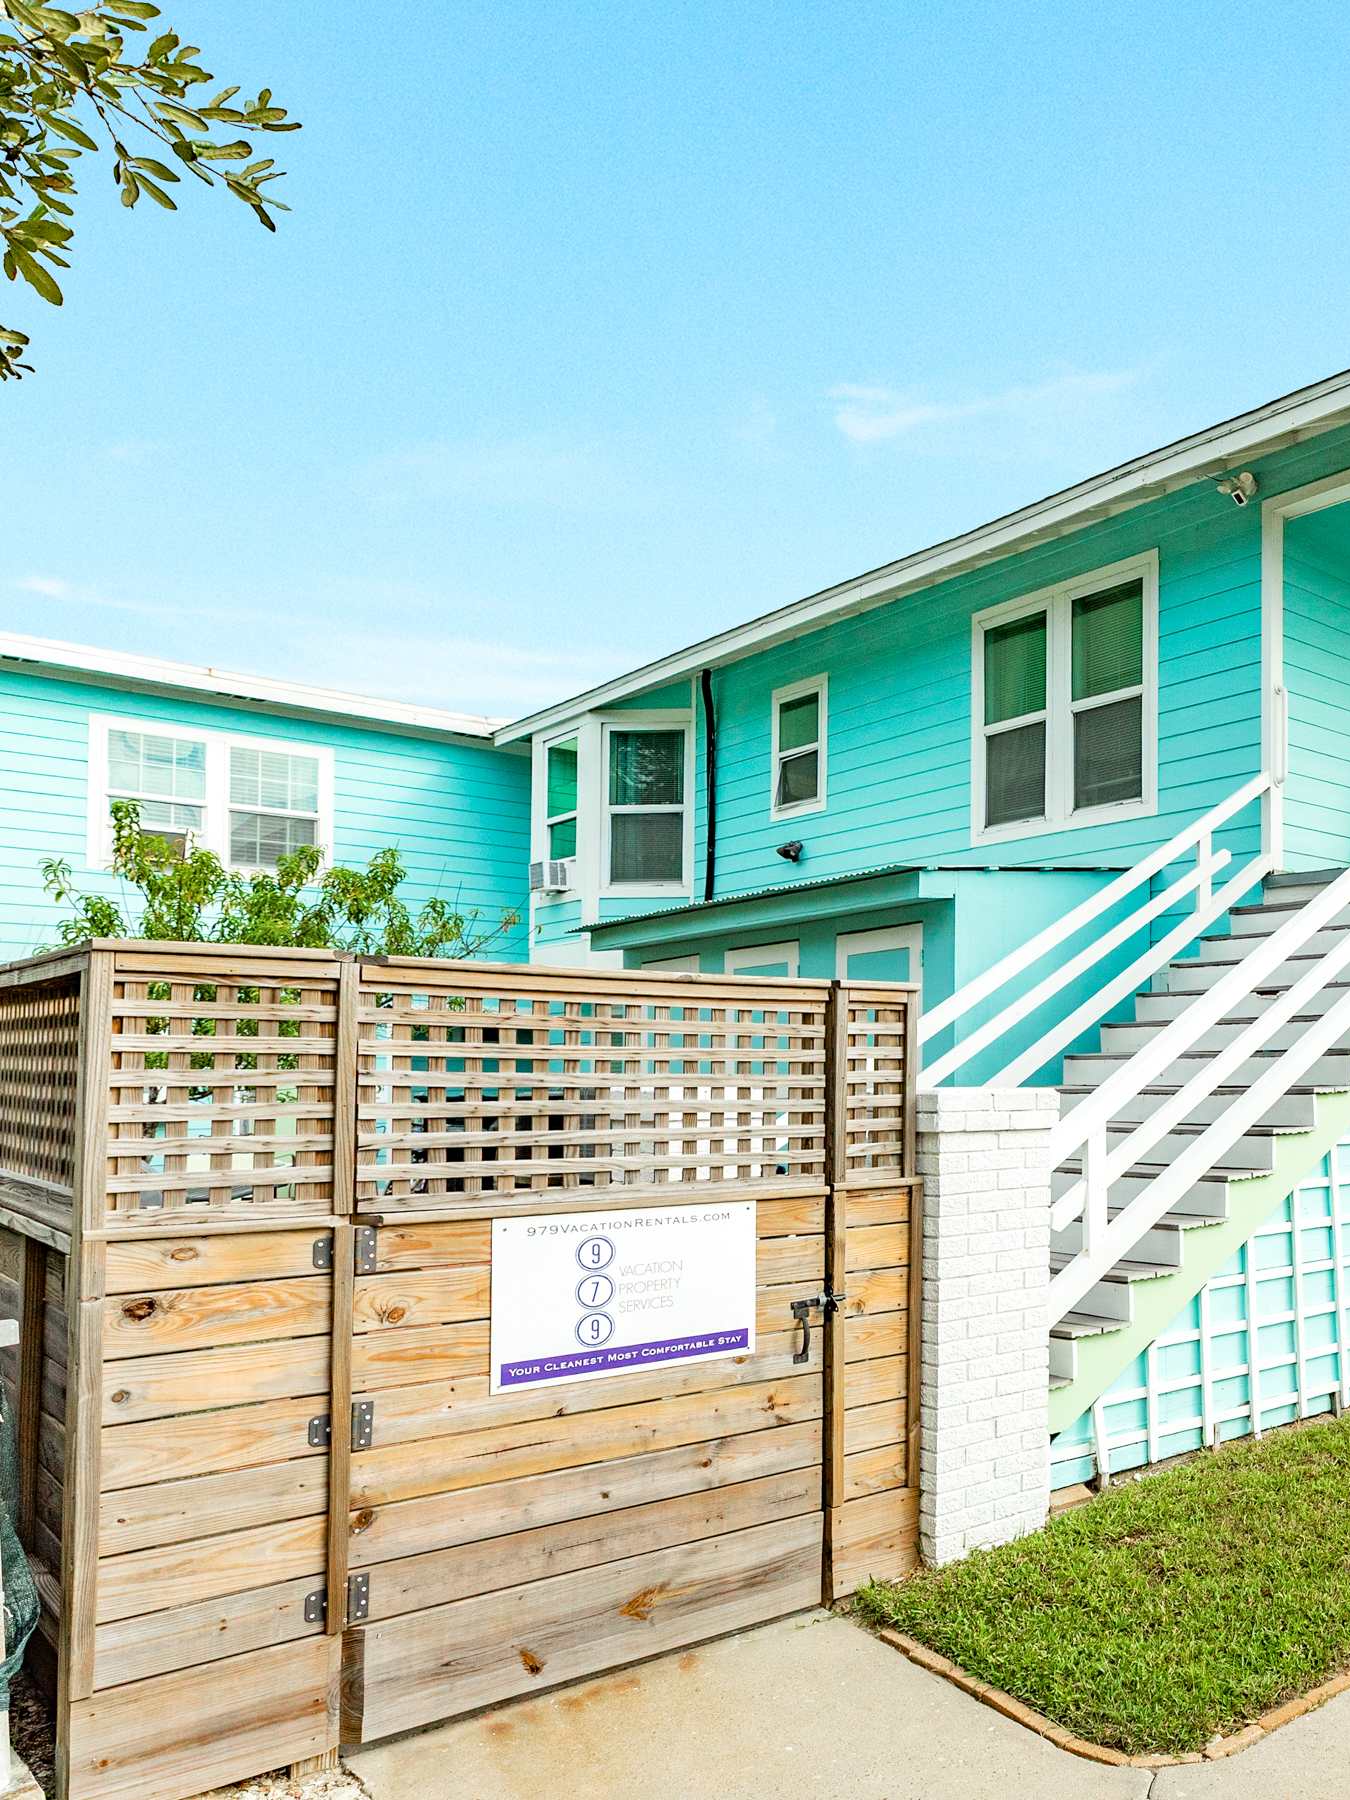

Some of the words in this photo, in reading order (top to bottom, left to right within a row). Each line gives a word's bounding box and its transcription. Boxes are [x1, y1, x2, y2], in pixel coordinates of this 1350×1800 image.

[591, 1243, 601, 1264] 9
[618, 1259, 683, 1277] VACATION
[591, 1281, 600, 1303] 7
[618, 1277, 681, 1295] PROPERTY
[618, 1295, 674, 1314] SERVICES
[591, 1318, 600, 1340] 9
[508, 1366, 541, 1377] YOUR
[543, 1356, 604, 1372] CLEANEST
[607, 1350, 639, 1362] MOST
[641, 1339, 715, 1357] COMFORTABLE
[717, 1335, 742, 1345] STAY
